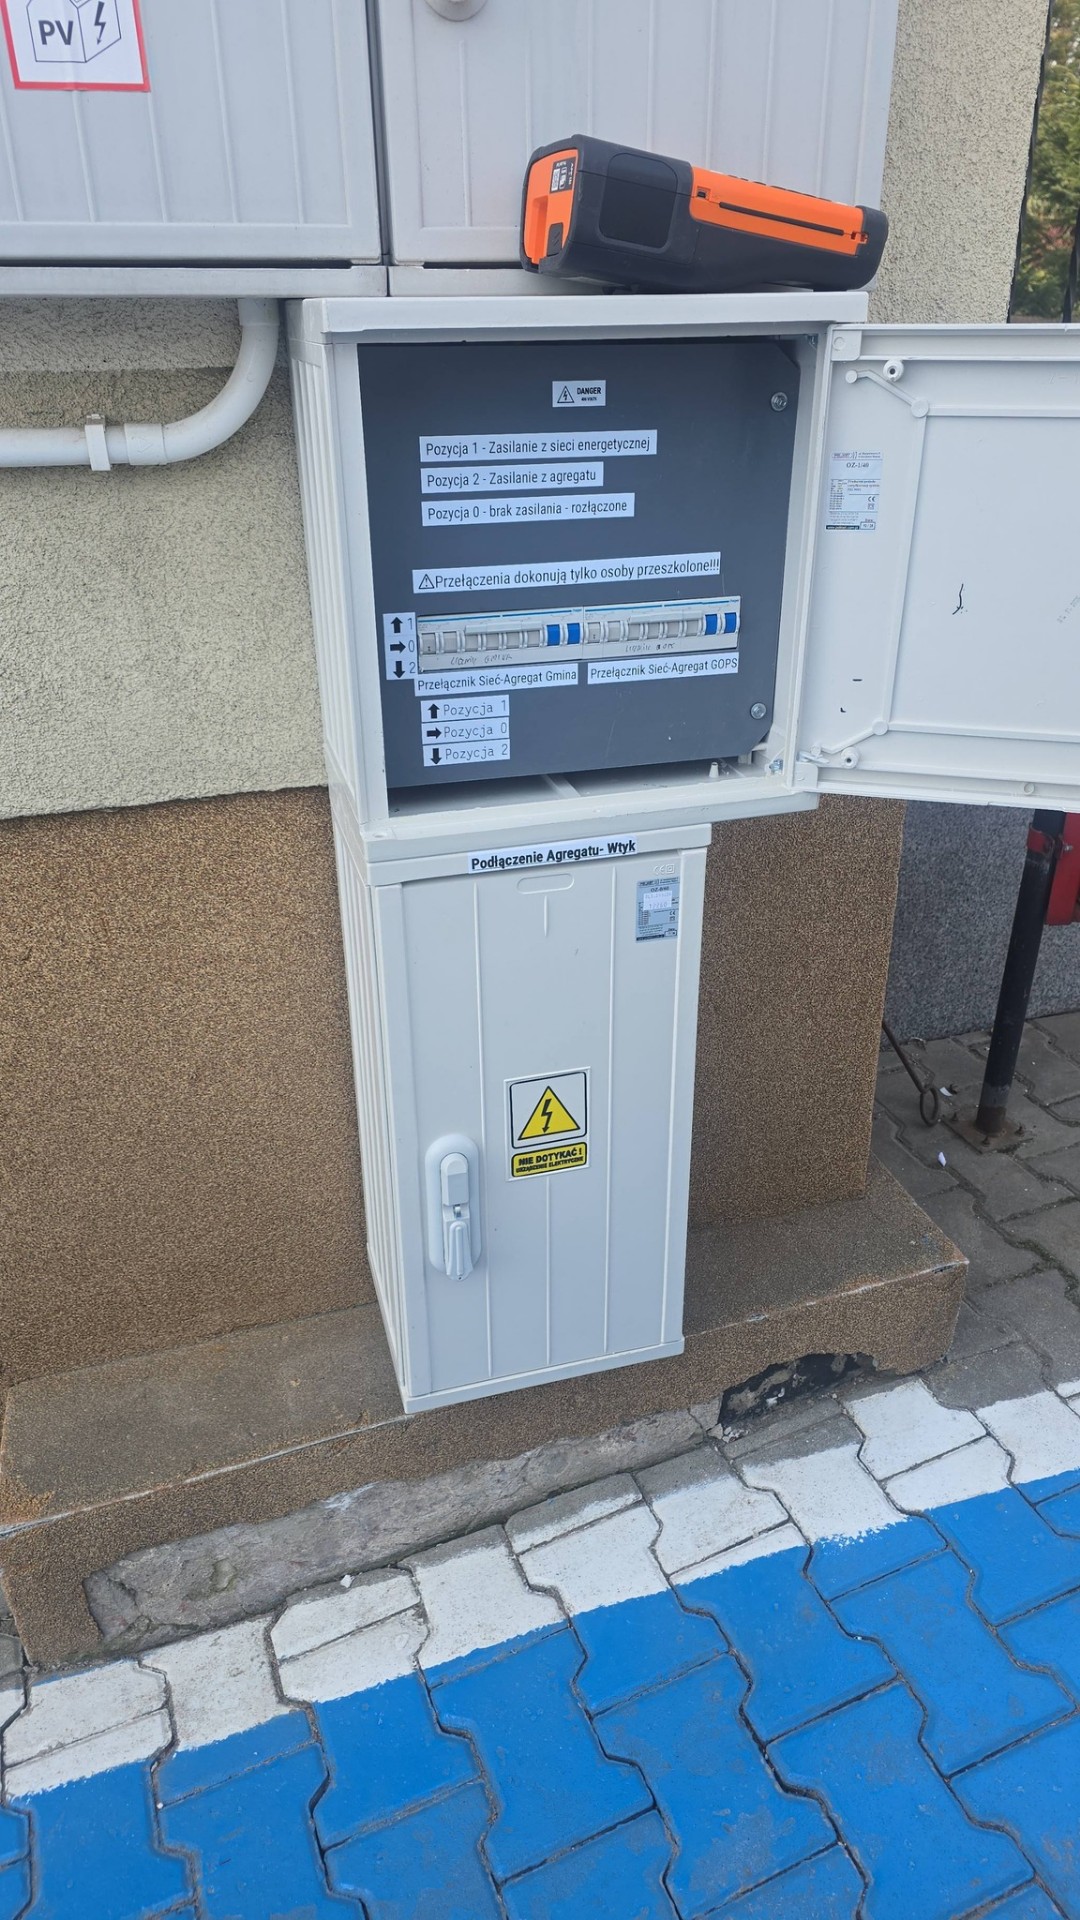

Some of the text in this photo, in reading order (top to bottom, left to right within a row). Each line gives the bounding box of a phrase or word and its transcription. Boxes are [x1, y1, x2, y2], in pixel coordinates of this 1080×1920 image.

[38, 20, 74, 46] PV
[577, 387, 602, 395] DANGER
[425, 442, 469, 458] Pozycja
[472, 442, 478, 454] 1
[489, 440, 538, 454] Zasilanie
[541, 442, 547, 453] z
[550, 438, 575, 452] sieci
[578, 436, 651, 453] energetycznej
[427, 474, 470, 490] Pozycja
[473, 473, 480, 485] 2
[489, 471, 538, 485] Zasilanie
[541, 473, 547, 483] z
[549, 469, 597, 485] agregatu
[428, 507, 470, 522] Pozycja
[472, 506, 480, 518] 0
[489, 504, 513, 517] brak
[515, 502, 562, 516] zasilania
[571, 500, 628, 515] rozłączone
[435, 559, 720, 590] Przełączenia dokonują tylko osoby przeszkolone!!!
[407, 618, 413, 630] 1
[408, 640, 415, 652] 0
[409, 662, 416, 674] 2
[591, 658, 738, 680] Przełącznik Sieć-Agregat GOPS
[418, 670, 577, 691] Przełącznik Sieć-Agregat Gmina
[443, 700, 506, 717] Pozycja 1
[444, 722, 507, 739] Pozycja 0
[445, 743, 508, 761] Pozycja 2
[471, 851, 543, 870] Podłączenie
[607, 840, 636, 856] Wtyk
[518, 1157, 534, 1166] NIE
[536, 1147, 577, 1164] DOTYKAĆ
